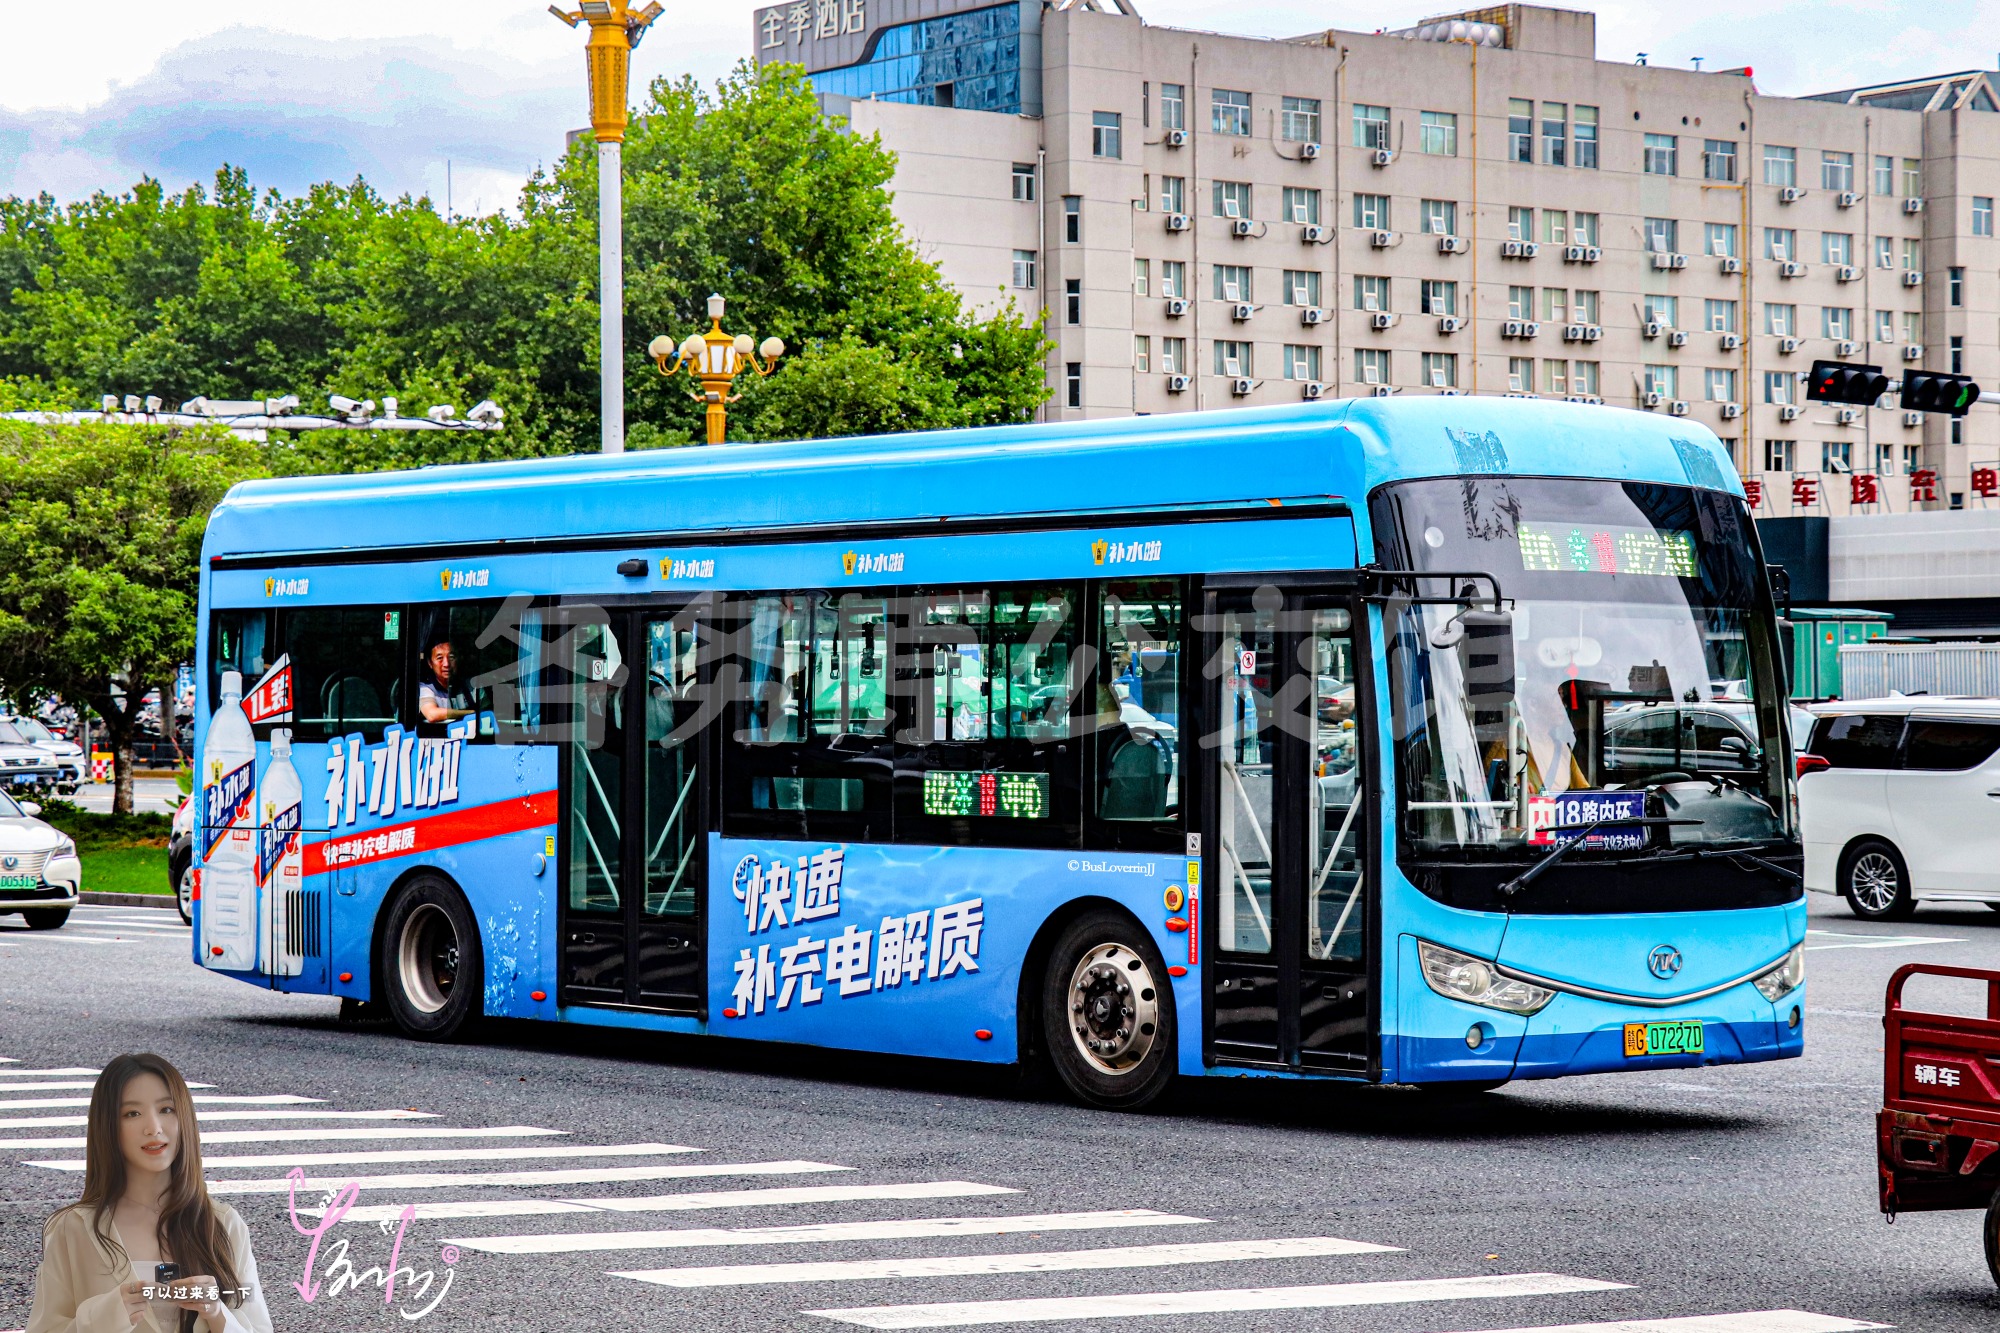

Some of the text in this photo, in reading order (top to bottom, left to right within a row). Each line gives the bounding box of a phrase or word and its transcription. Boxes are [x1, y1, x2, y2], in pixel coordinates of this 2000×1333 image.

[760, 0, 866, 49] 全季酒店
[858, 553, 905, 573] 补水啦
[1109, 540, 1162, 564] 补水啦
[453, 568, 490, 588] 补水啦
[673, 559, 715, 579] 补水啦
[276, 578, 310, 596] 补水啦
[250, 673, 289, 721] 1L装
[1528, 799, 1556, 842] 内
[1556, 800, 1632, 824] 18路内环
[324, 826, 416, 867] 快速补充电解质
[1603, 834, 1643, 852] 文化艺术中心
[743, 847, 844, 933] 快速
[731, 897, 984, 1018] 补充电解质
[1914, 1063, 1961, 1088] 辆车
